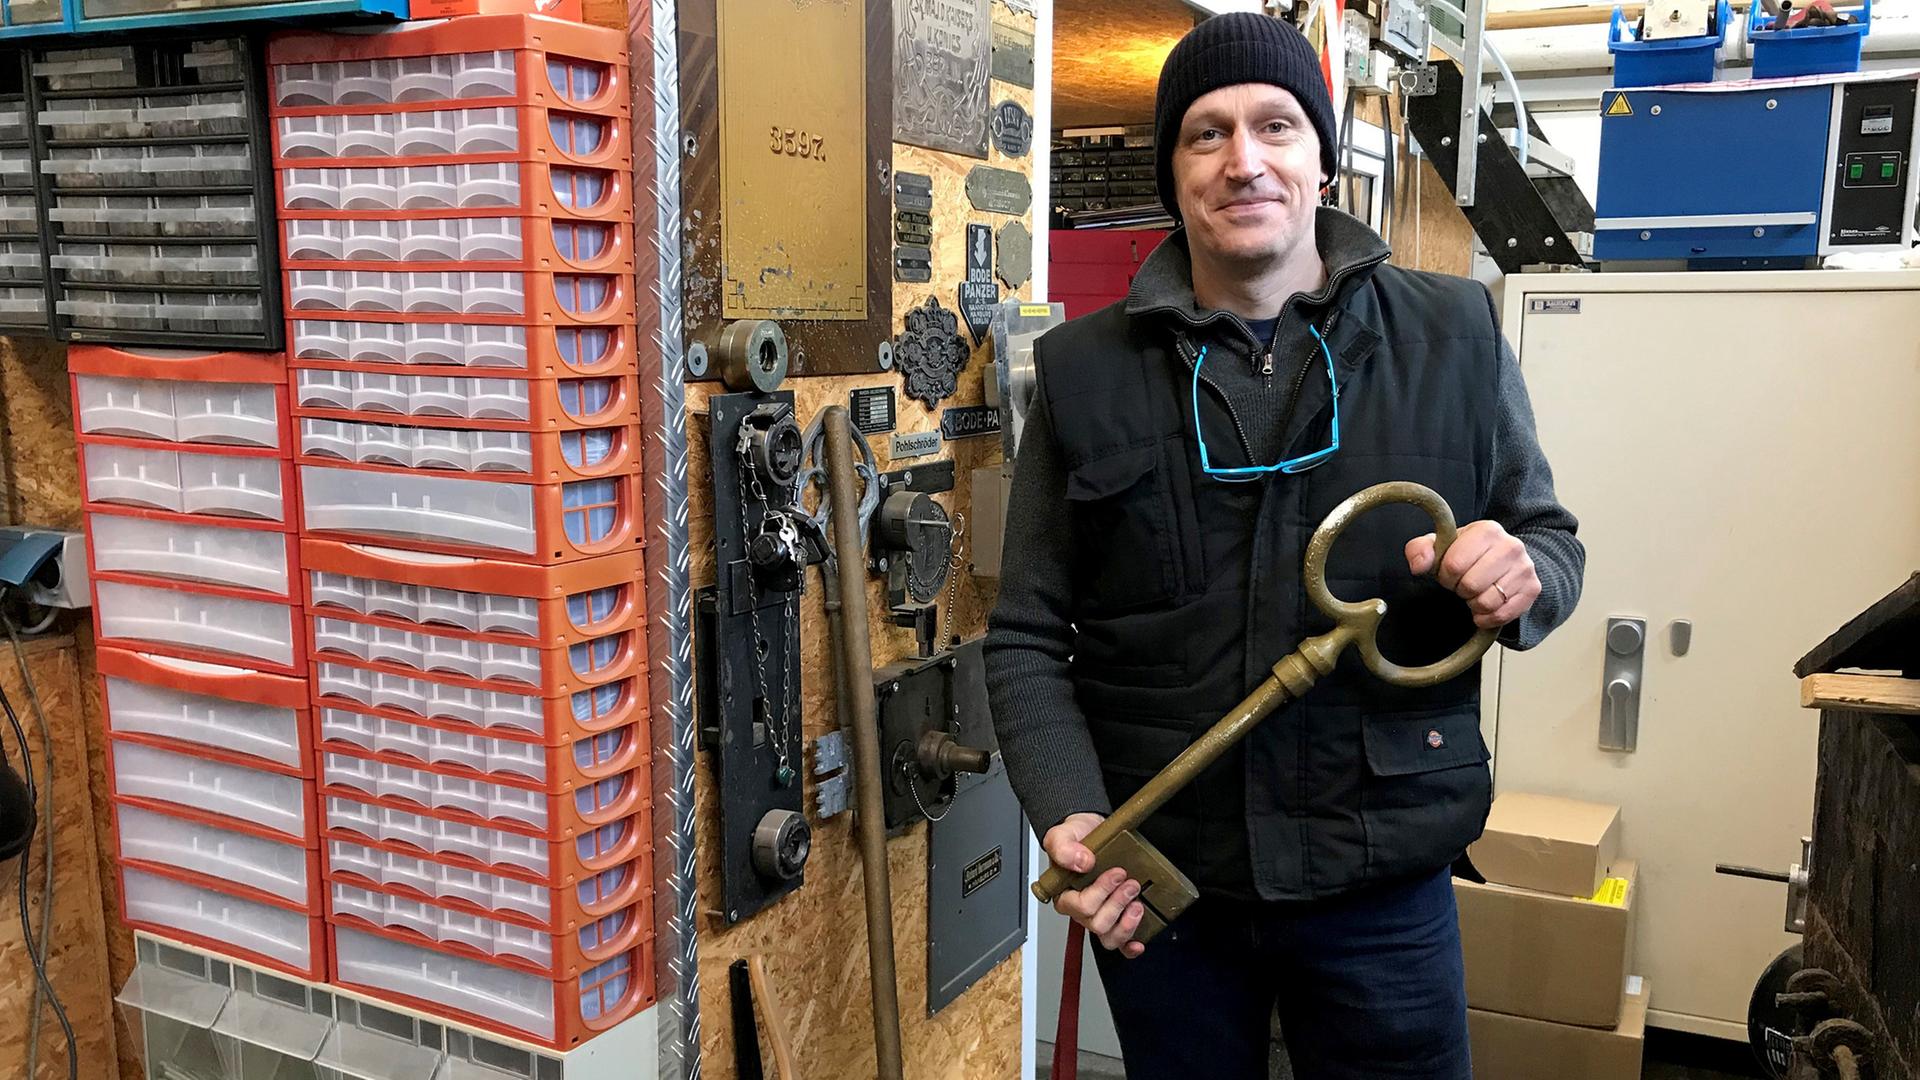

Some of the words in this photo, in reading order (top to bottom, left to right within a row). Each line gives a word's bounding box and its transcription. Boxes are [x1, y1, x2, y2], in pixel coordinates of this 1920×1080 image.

[970, 268, 991, 283] BODE
[964, 284, 997, 299] PANZER
[895, 437, 939, 453] Pohlschröder
